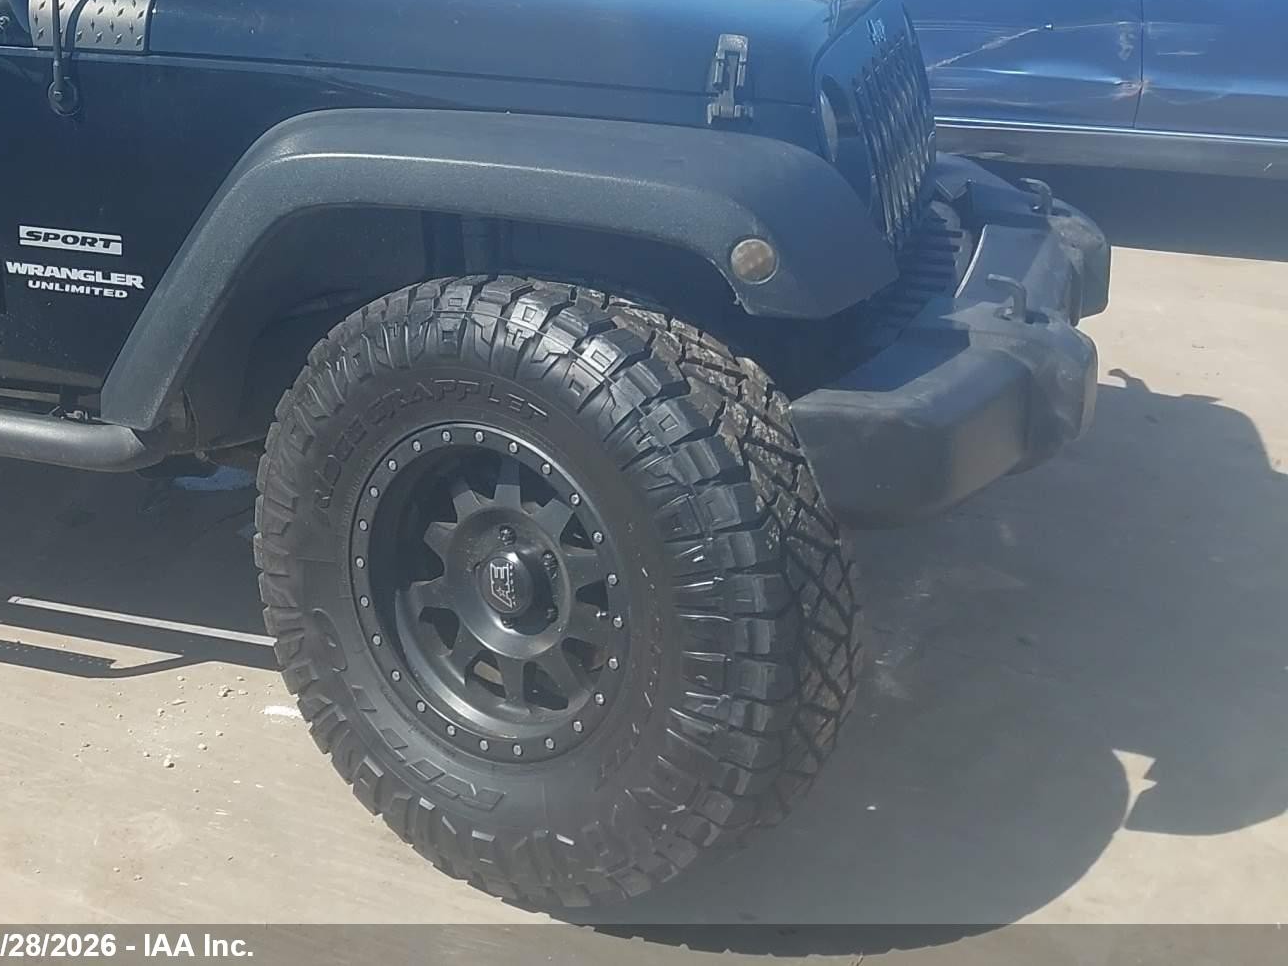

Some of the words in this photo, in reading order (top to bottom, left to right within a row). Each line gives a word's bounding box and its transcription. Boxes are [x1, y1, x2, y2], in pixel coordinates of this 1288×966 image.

[21, 229, 121, 251] SPORT
[5, 260, 145, 290] WRANGLER
[27, 279, 128, 299] UNLIMITED
